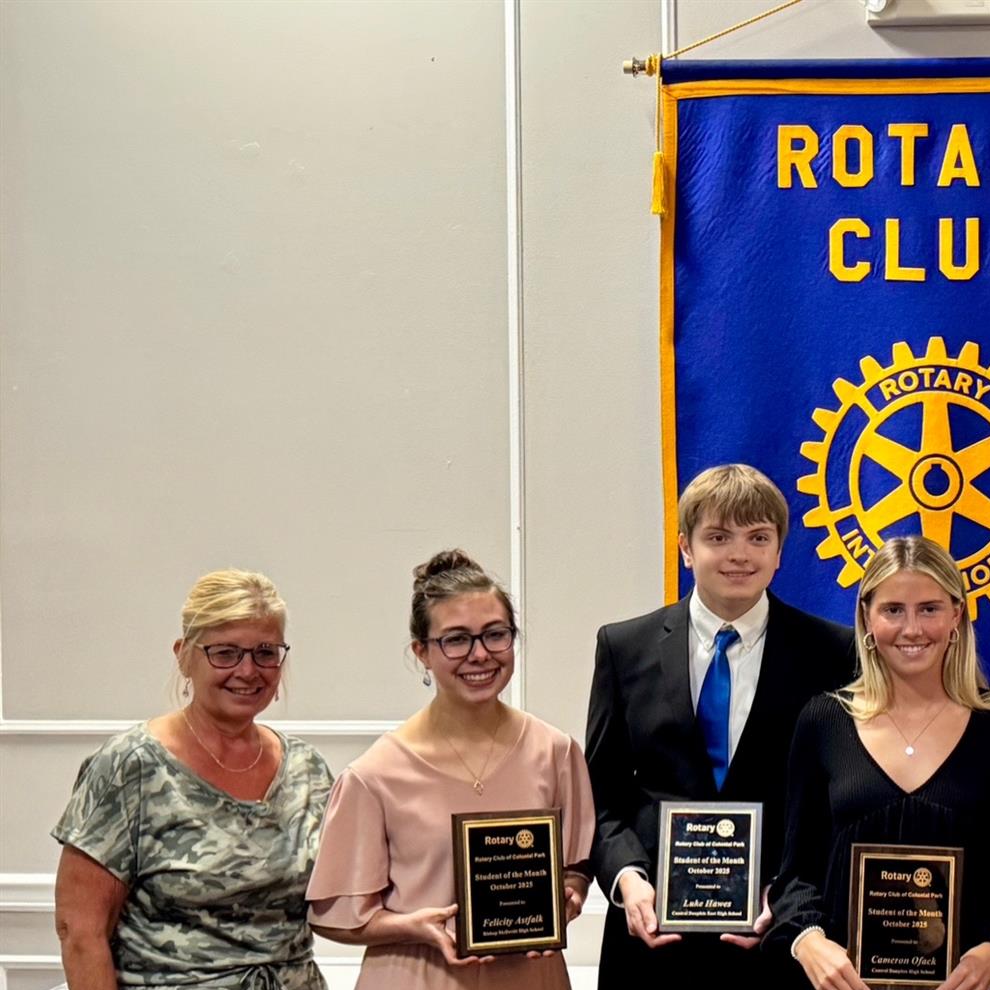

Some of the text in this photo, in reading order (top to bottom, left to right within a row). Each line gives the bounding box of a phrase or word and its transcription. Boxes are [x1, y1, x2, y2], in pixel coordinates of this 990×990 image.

[686, 823, 715, 833] Rotary
[485, 835, 514, 846] Rotary
[722, 857, 745, 865] Month
[475, 873, 502, 881] Student
[511, 870, 523, 878] the
[524, 869, 547, 877] Month
[881, 871, 912, 882] Rotary
[490, 883, 516, 891] October
[683, 899, 732, 908] Luke Hawes
[868, 908, 896, 916] Student
[906, 909, 917, 917] the
[918, 909, 943, 917] Month
[482, 914, 543, 927] Felicity Astfalk
[883, 920, 910, 928] October
[871, 955, 936, 967] Cameron Ofack
